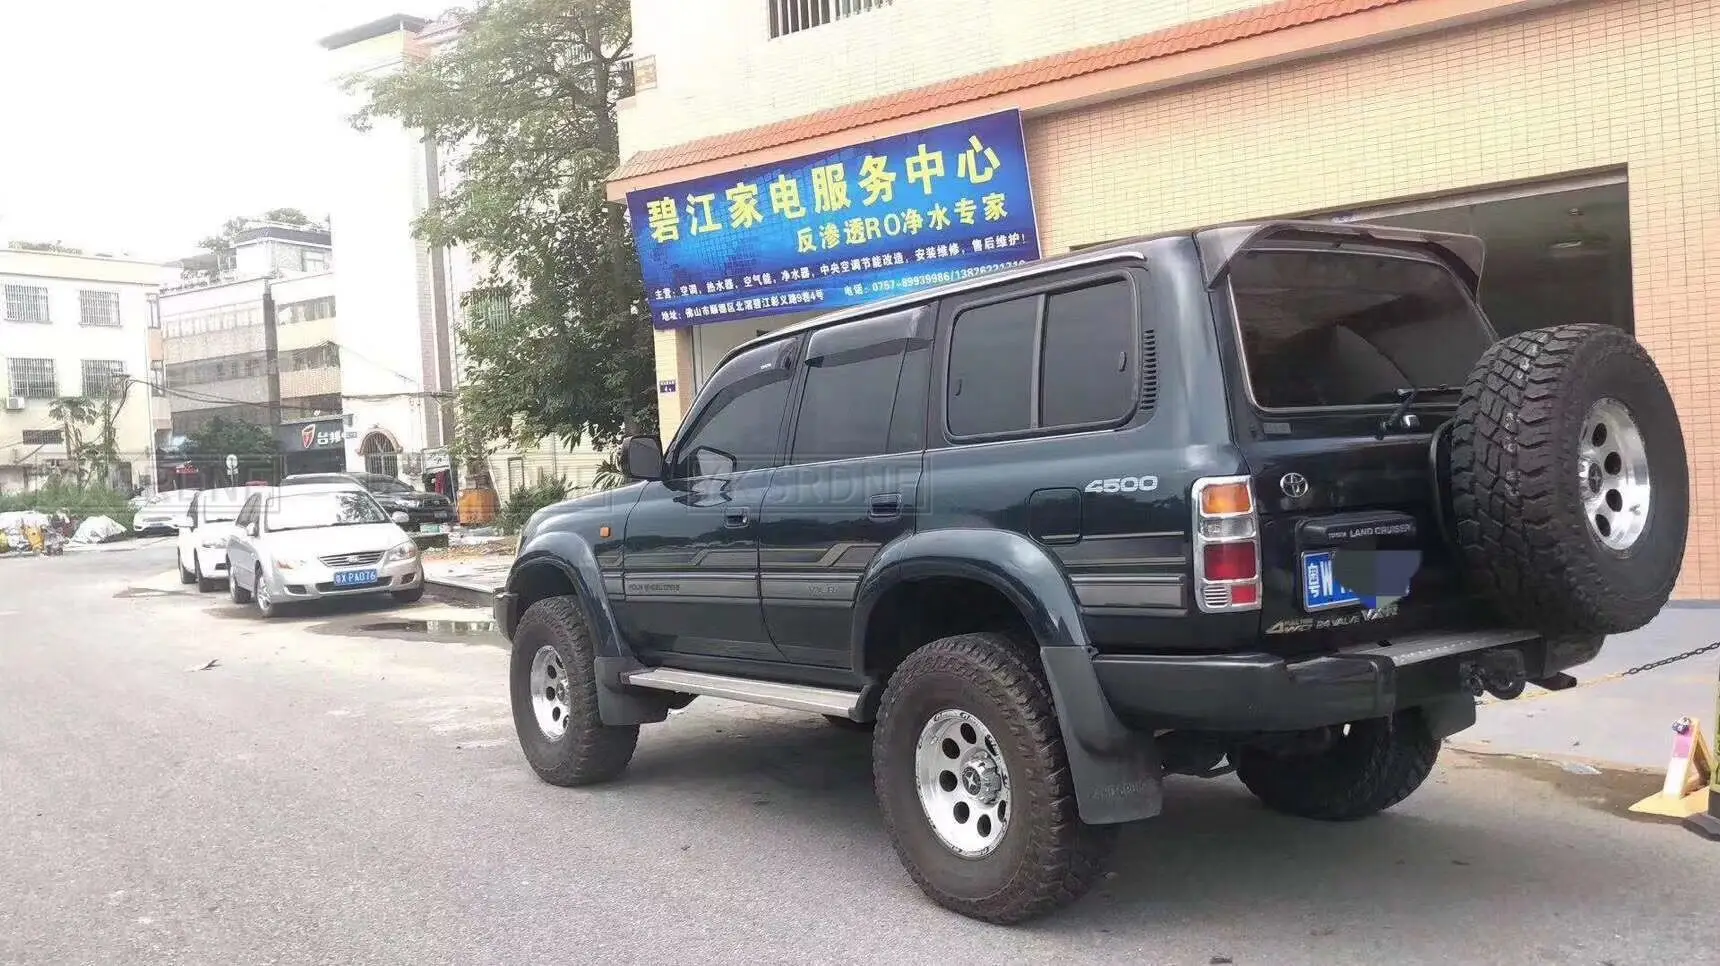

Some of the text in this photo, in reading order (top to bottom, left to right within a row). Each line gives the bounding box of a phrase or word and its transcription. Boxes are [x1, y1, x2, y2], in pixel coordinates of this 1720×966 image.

[647, 135, 1001, 243] 碧江家电服务中心
[797, 192, 1008, 253] 反渗透RO净水专家
[1084, 475, 1158, 493] 4500
[1350, 527, 1374, 538] LAND
[1375, 523, 1411, 535] CRUISER
